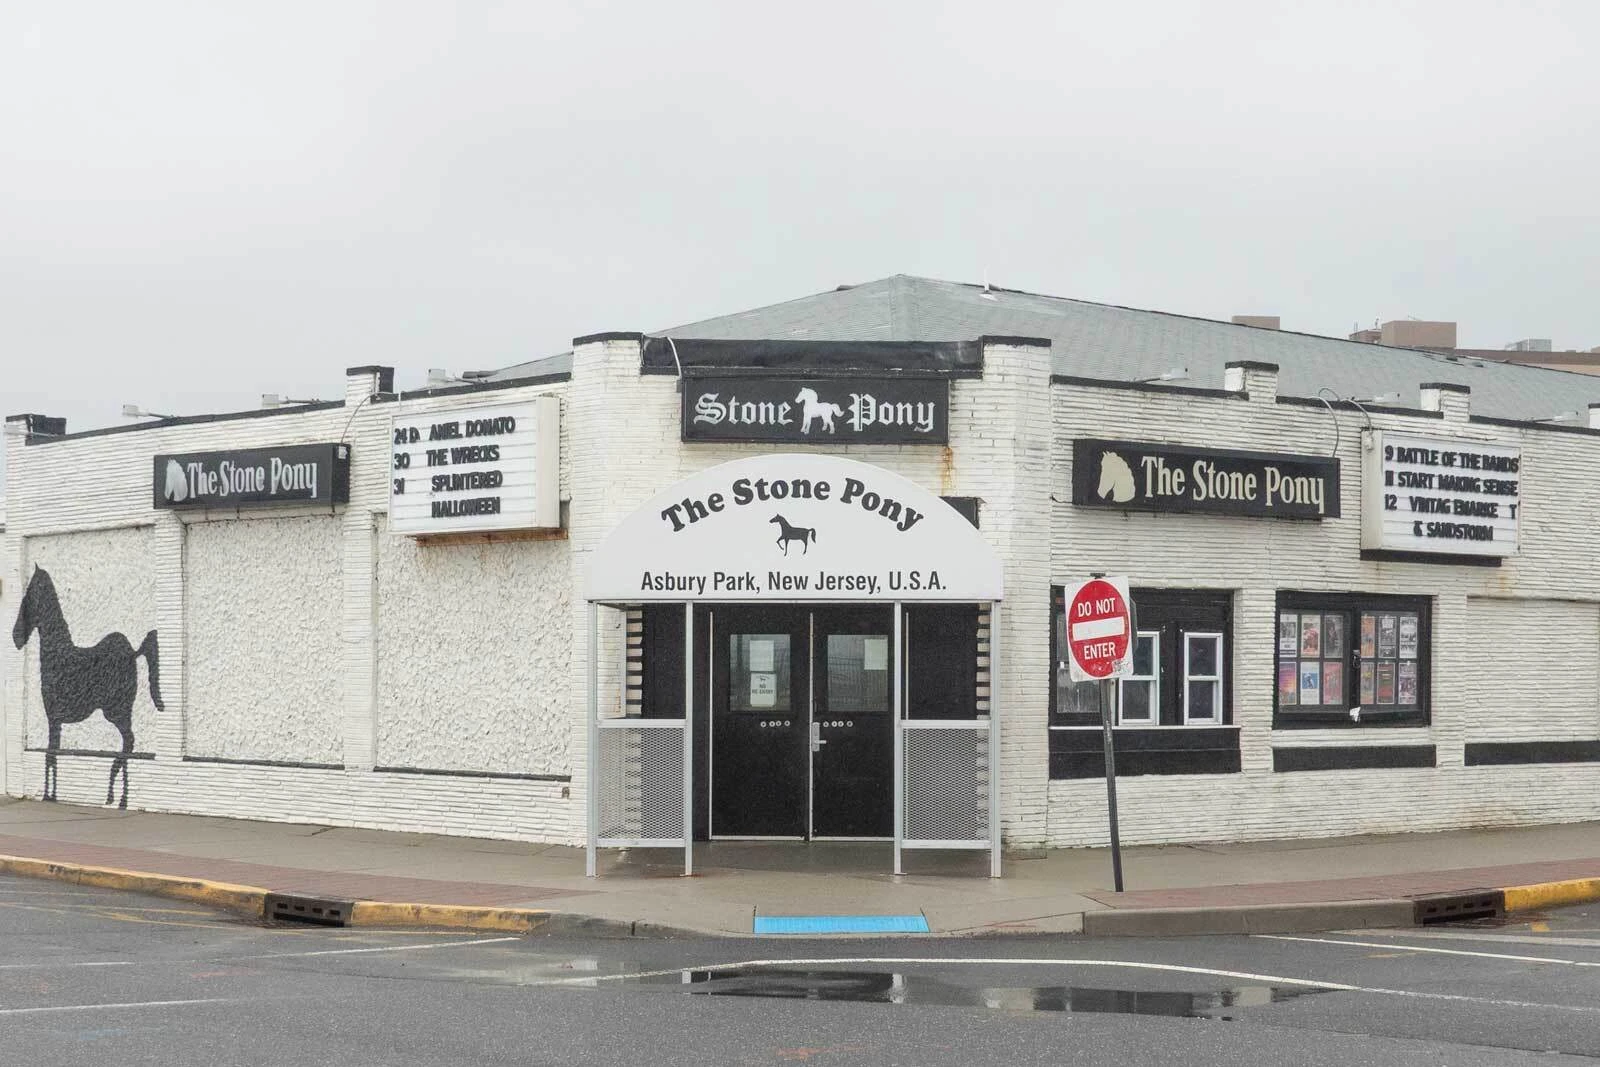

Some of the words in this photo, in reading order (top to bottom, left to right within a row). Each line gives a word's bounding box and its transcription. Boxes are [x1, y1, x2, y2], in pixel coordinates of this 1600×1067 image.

[693, 392, 793, 426] Stone
[846, 392, 936, 433] Pony
[465, 416, 516, 438] DONATO
[394, 452, 410, 470] 30
[426, 448, 449, 467] THE
[451, 444, 500, 465] WRECKS
[1384, 445, 1394, 461] 9
[1396, 446, 1439, 466] BATTLE
[1441, 451, 1458, 467] OF
[1459, 452, 1481, 470] THE
[1482, 454, 1519, 473] BANDS
[187, 461, 218, 499] The
[219, 459, 265, 497] Stone
[270, 456, 318, 498] Pony
[393, 478, 405, 495] 31
[431, 470, 503, 492] SPLINTERED
[1140, 456, 1185, 498] The
[1192, 459, 1257, 501] Stone
[1264, 466, 1325, 514] Pony
[1397, 471, 1435, 489] START
[1438, 474, 1481, 493] MAKING
[1483, 479, 1518, 496] SENSE
[431, 496, 501, 518] HALLOWEEN
[661, 491, 725, 533] The
[732, 477, 831, 506] Stone
[840, 477, 925, 533] Pony
[1384, 494, 1397, 511] 12
[1413, 520, 1423, 537] &
[1426, 521, 1494, 541] SANDSTORM
[641, 570, 707, 596] Asbury
[713, 570, 761, 594] Park,
[768, 571, 807, 591] New
[814, 570, 881, 596] Jersey,
[888, 570, 947, 591] U.S.A.
[1078, 601, 1092, 617] DO
[1096, 598, 1115, 615] NOT
[1083, 641, 1116, 660] ENTER
